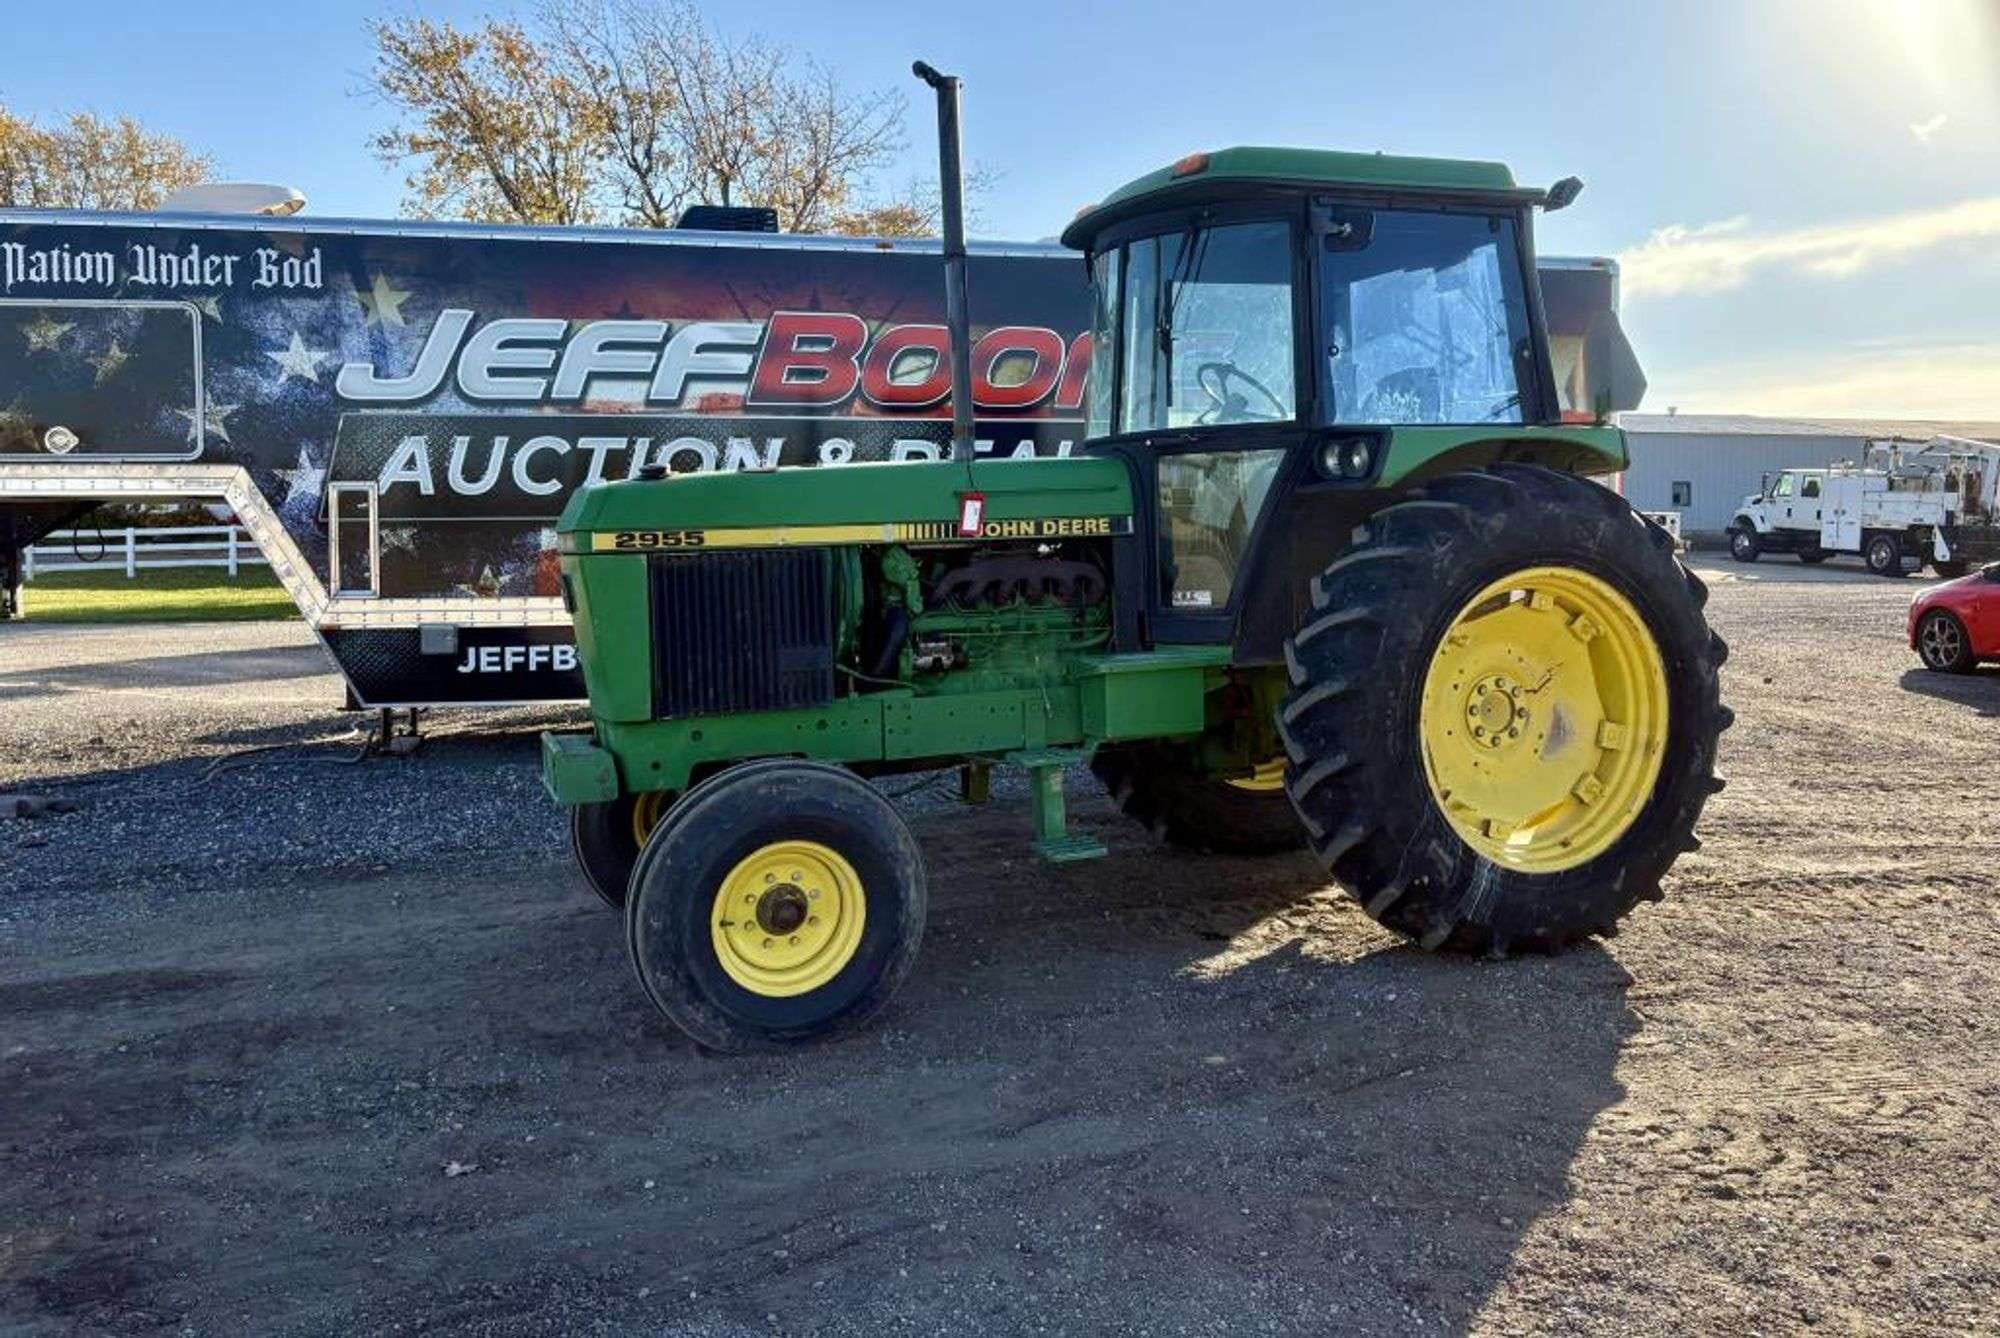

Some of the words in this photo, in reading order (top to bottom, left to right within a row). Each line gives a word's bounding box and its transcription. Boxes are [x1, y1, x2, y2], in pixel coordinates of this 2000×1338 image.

[1, 242, 115, 294] Nation
[127, 243, 241, 288] Under
[251, 247, 324, 289] God
[1043, 518, 1110, 535] DEERE
[615, 531, 704, 548] 2955
